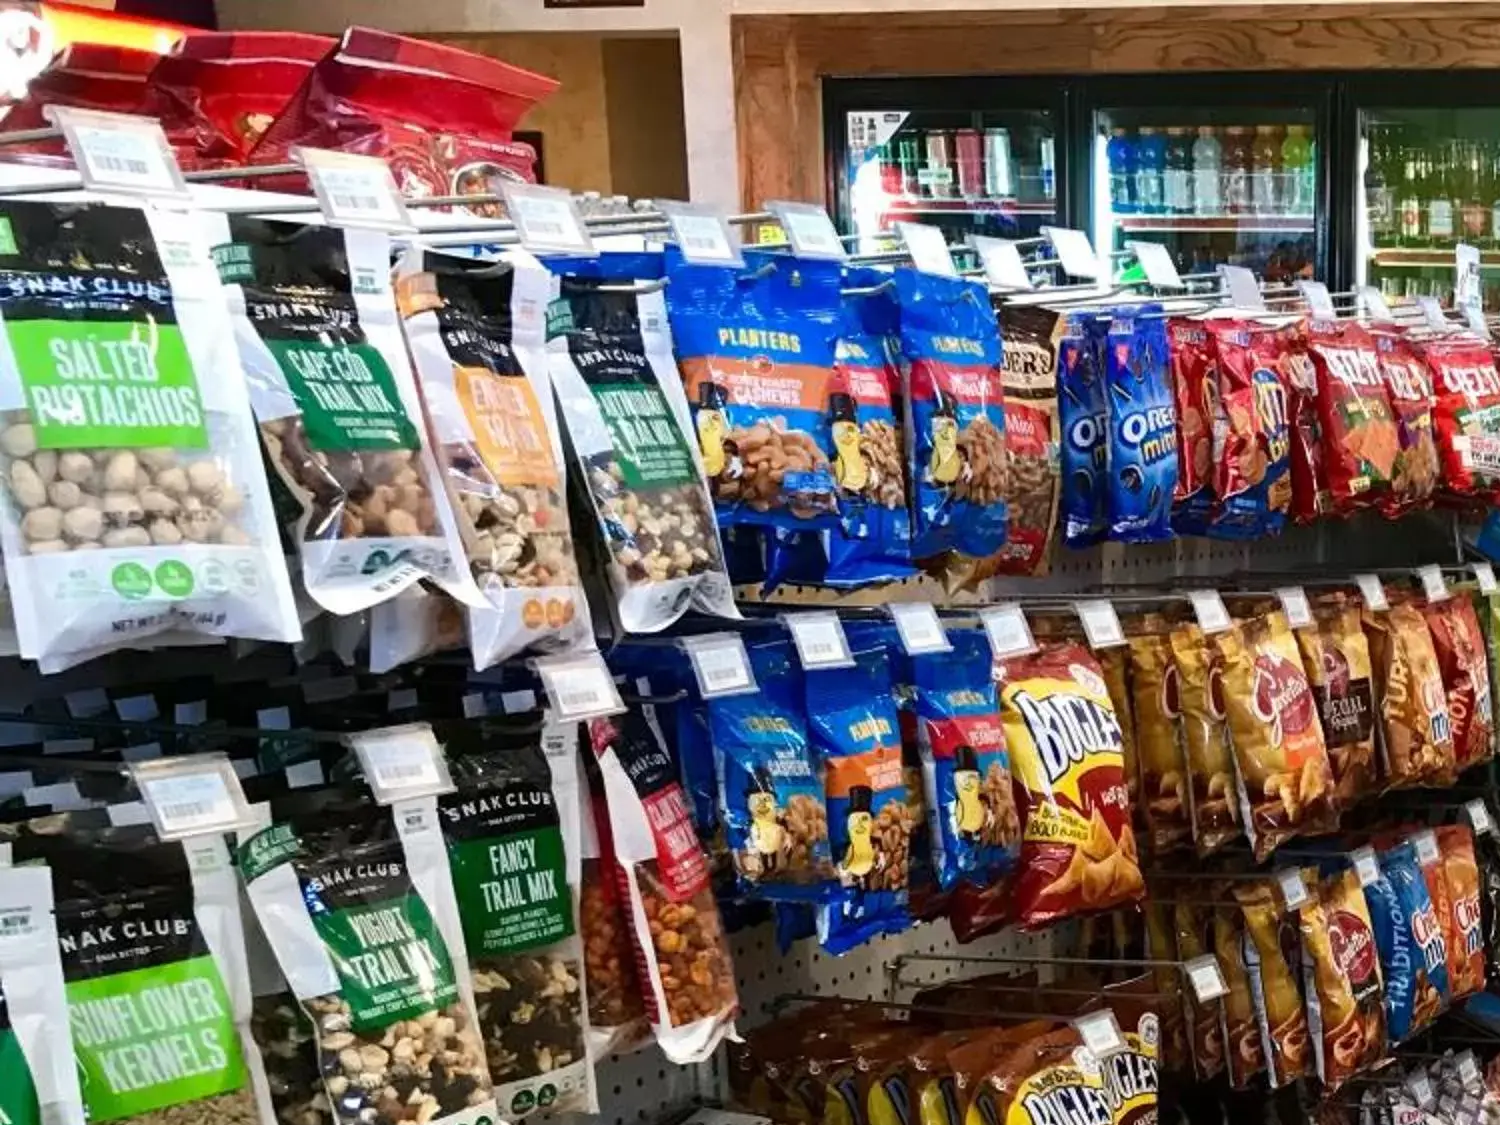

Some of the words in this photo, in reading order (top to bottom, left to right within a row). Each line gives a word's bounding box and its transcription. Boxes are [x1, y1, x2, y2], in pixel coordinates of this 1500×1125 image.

[50, 337, 159, 382] SALTED
[718, 328, 801, 353] PLANTERS
[357, 863, 400, 879] CLUB
[489, 838, 537, 876] FANCY
[480, 878, 527, 913] TRAIL
[528, 869, 559, 903] MIX
[59, 925, 115, 953] NAK
[125, 918, 190, 938] CLUB
[69, 977, 224, 1045] SUNFLOWER
[97, 1031, 229, 1094] KERNELS
